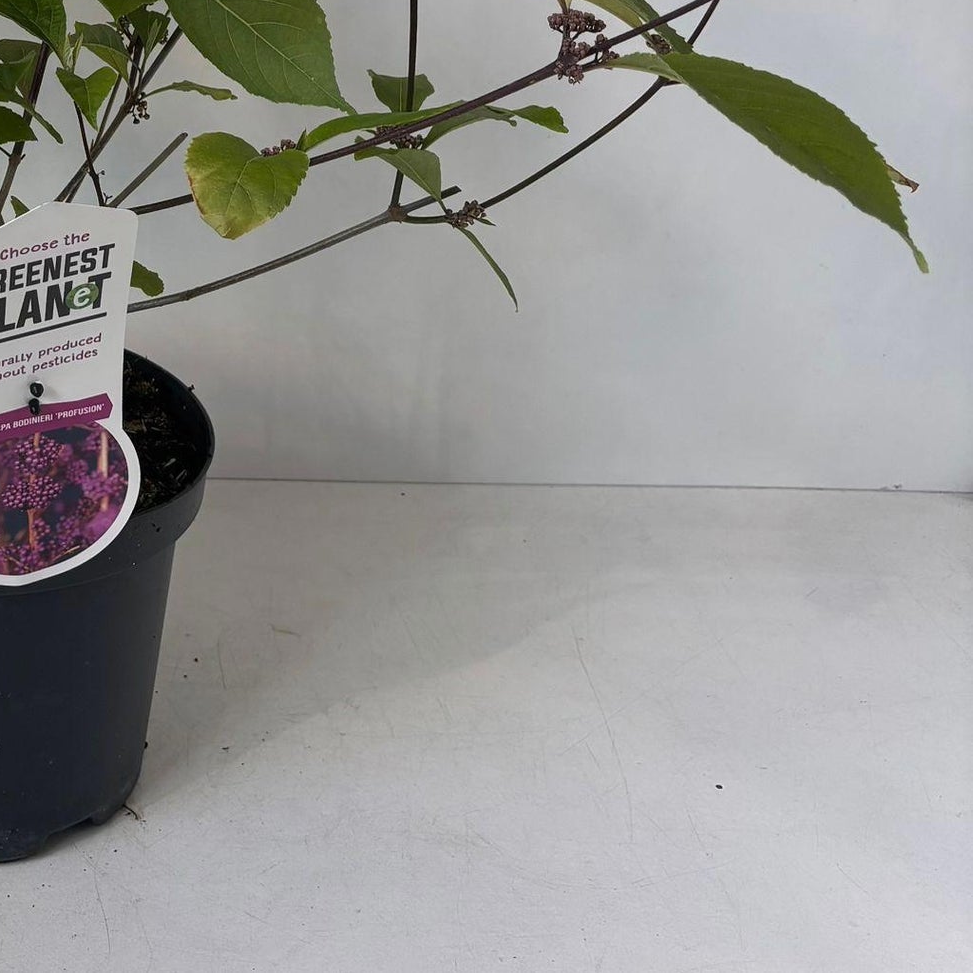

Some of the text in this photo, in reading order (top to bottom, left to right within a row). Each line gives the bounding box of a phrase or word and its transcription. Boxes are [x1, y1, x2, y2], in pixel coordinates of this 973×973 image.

[0, 232, 90, 260] Choose the
[38, 333, 102, 359] produced
[32, 348, 98, 373] pesticides
[13, 414, 53, 428] BODINIERI
[55, 403, 105, 420] 'PROFUSION'
